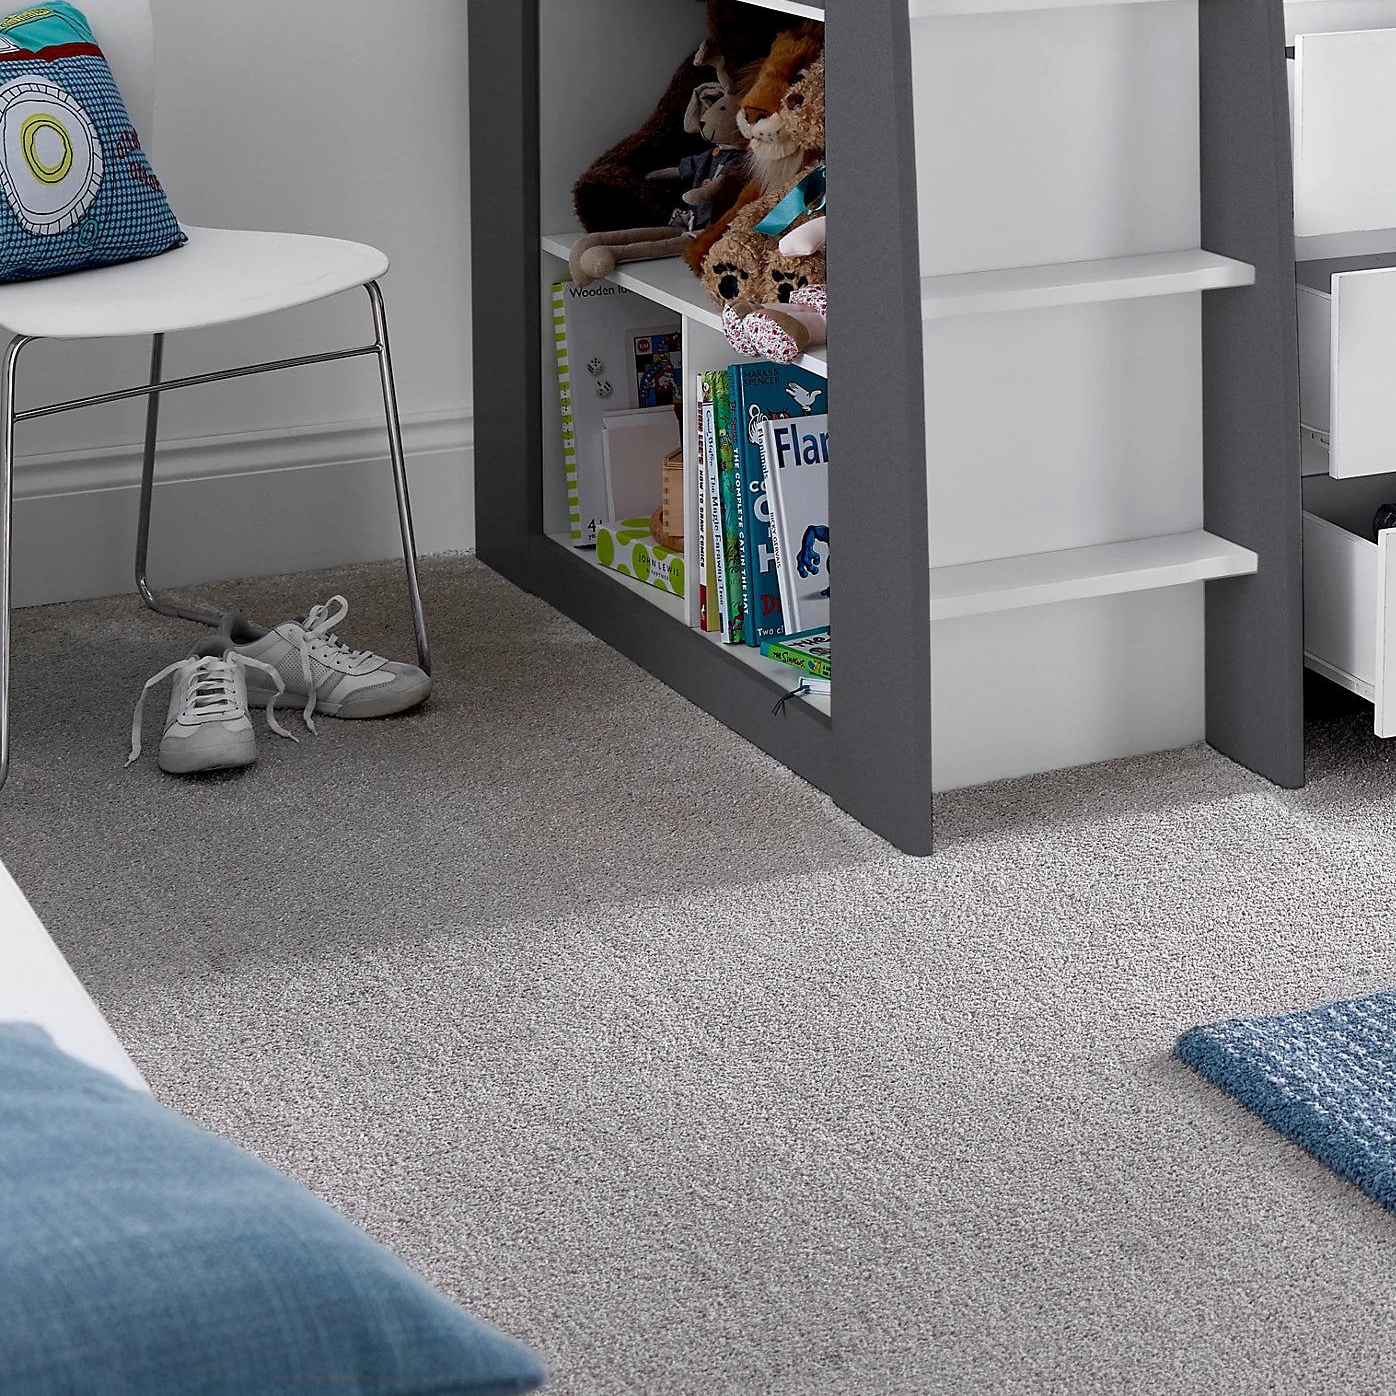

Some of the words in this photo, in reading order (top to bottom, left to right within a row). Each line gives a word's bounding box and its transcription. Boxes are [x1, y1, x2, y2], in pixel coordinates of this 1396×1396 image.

[569, 286, 615, 298] Wooden
[744, 376, 780, 387] SPENCER
[711, 496, 720, 531] Magic
[735, 472, 744, 528] COMPLETE
[740, 555, 746, 566] IN
[638, 554, 656, 567] JOHN
[658, 562, 680, 577] LEWIS
[757, 627, 774, 637] Two
